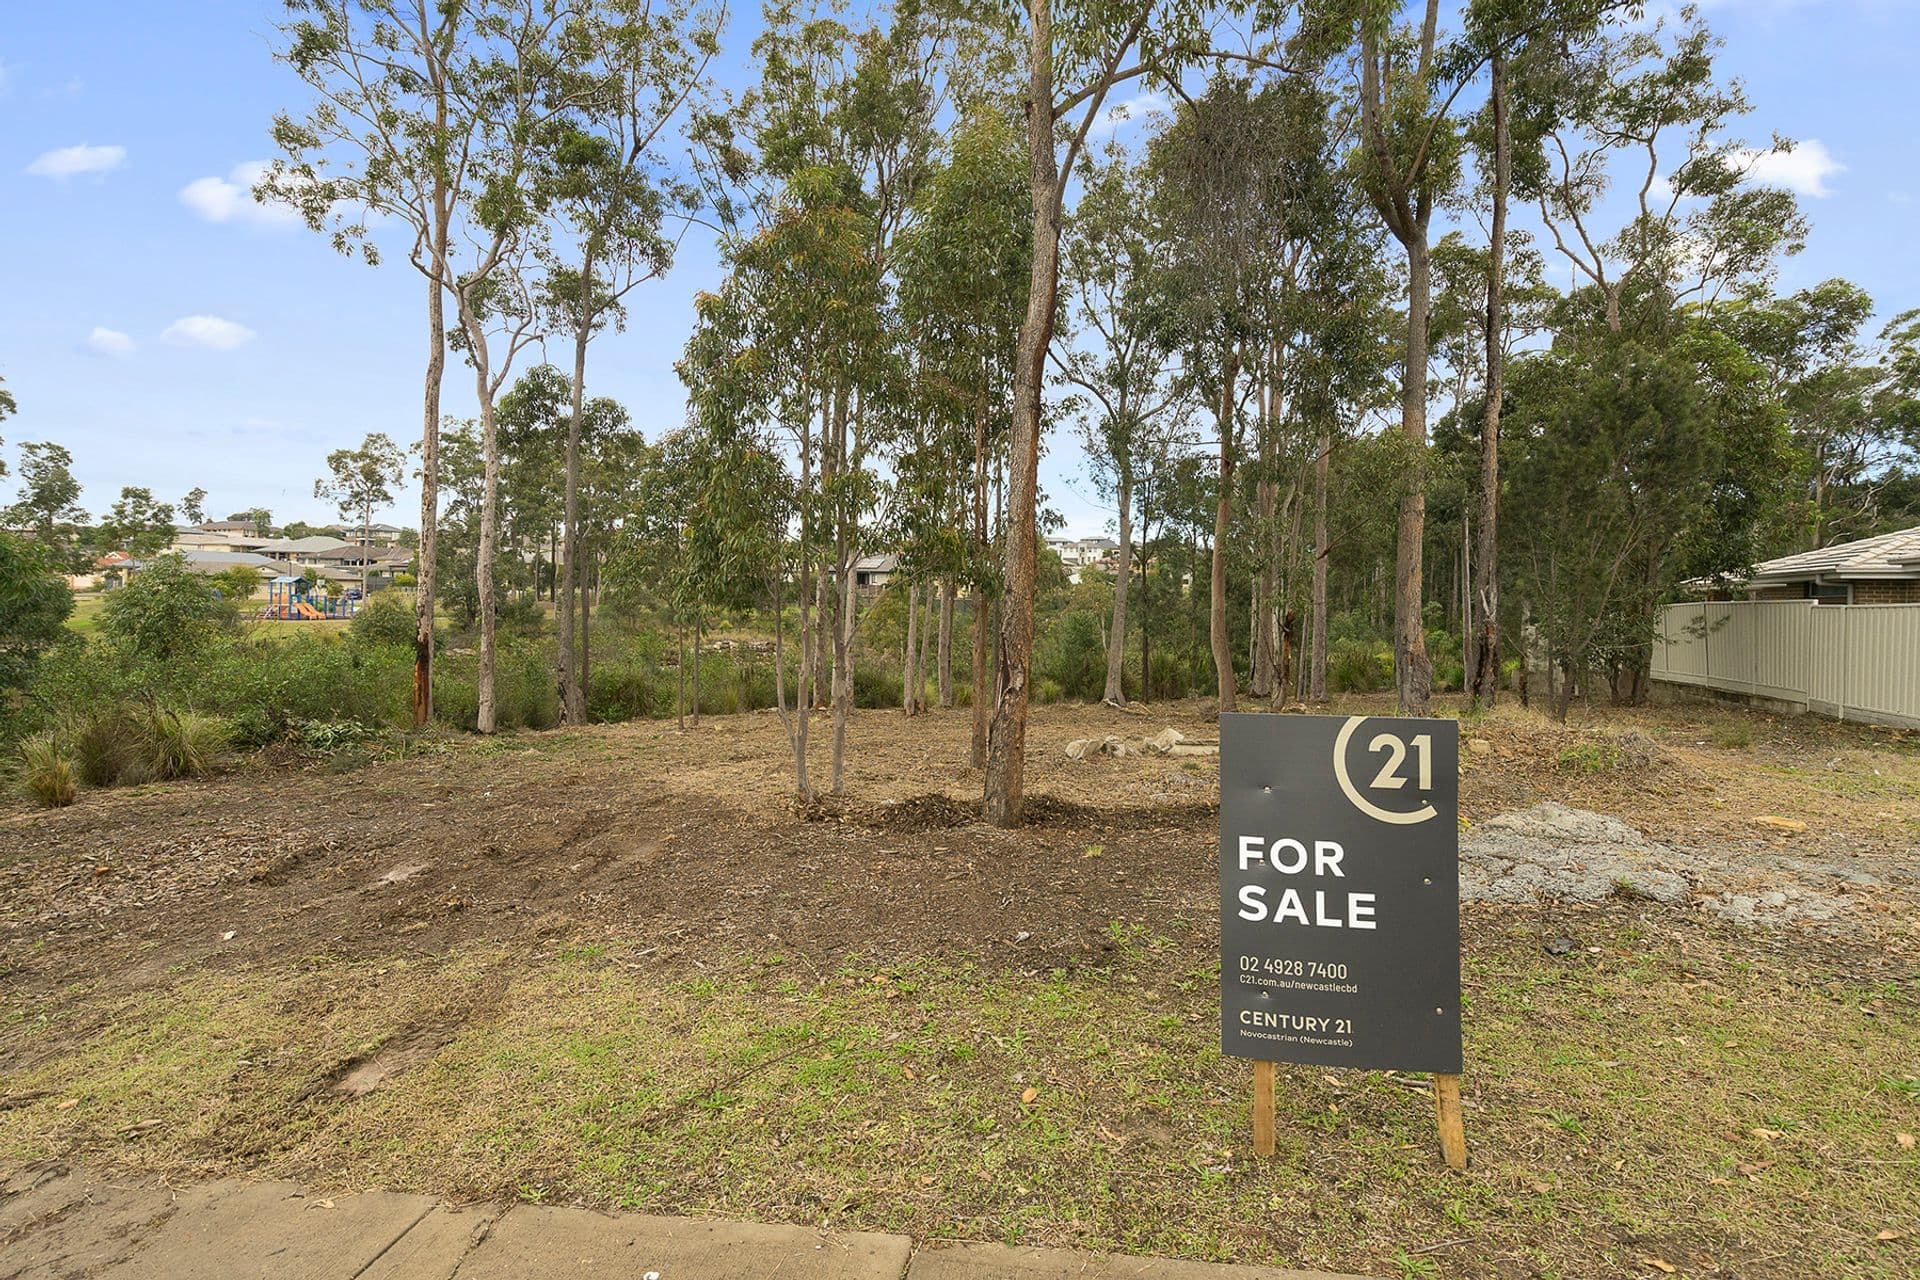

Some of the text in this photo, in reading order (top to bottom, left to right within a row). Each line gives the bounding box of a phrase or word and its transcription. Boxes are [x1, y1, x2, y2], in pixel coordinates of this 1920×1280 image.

[1238, 835, 1346, 878] FOR
[1237, 884, 1377, 930] SALE
[1239, 955, 1348, 980] 02 4928 7400
[1239, 973, 1358, 994] C21.com.au/newcastlecbd
[1239, 1009, 1352, 1034] CENTURY 21
[1239, 1028, 1353, 1048] Novocastrian (Newcastle)
